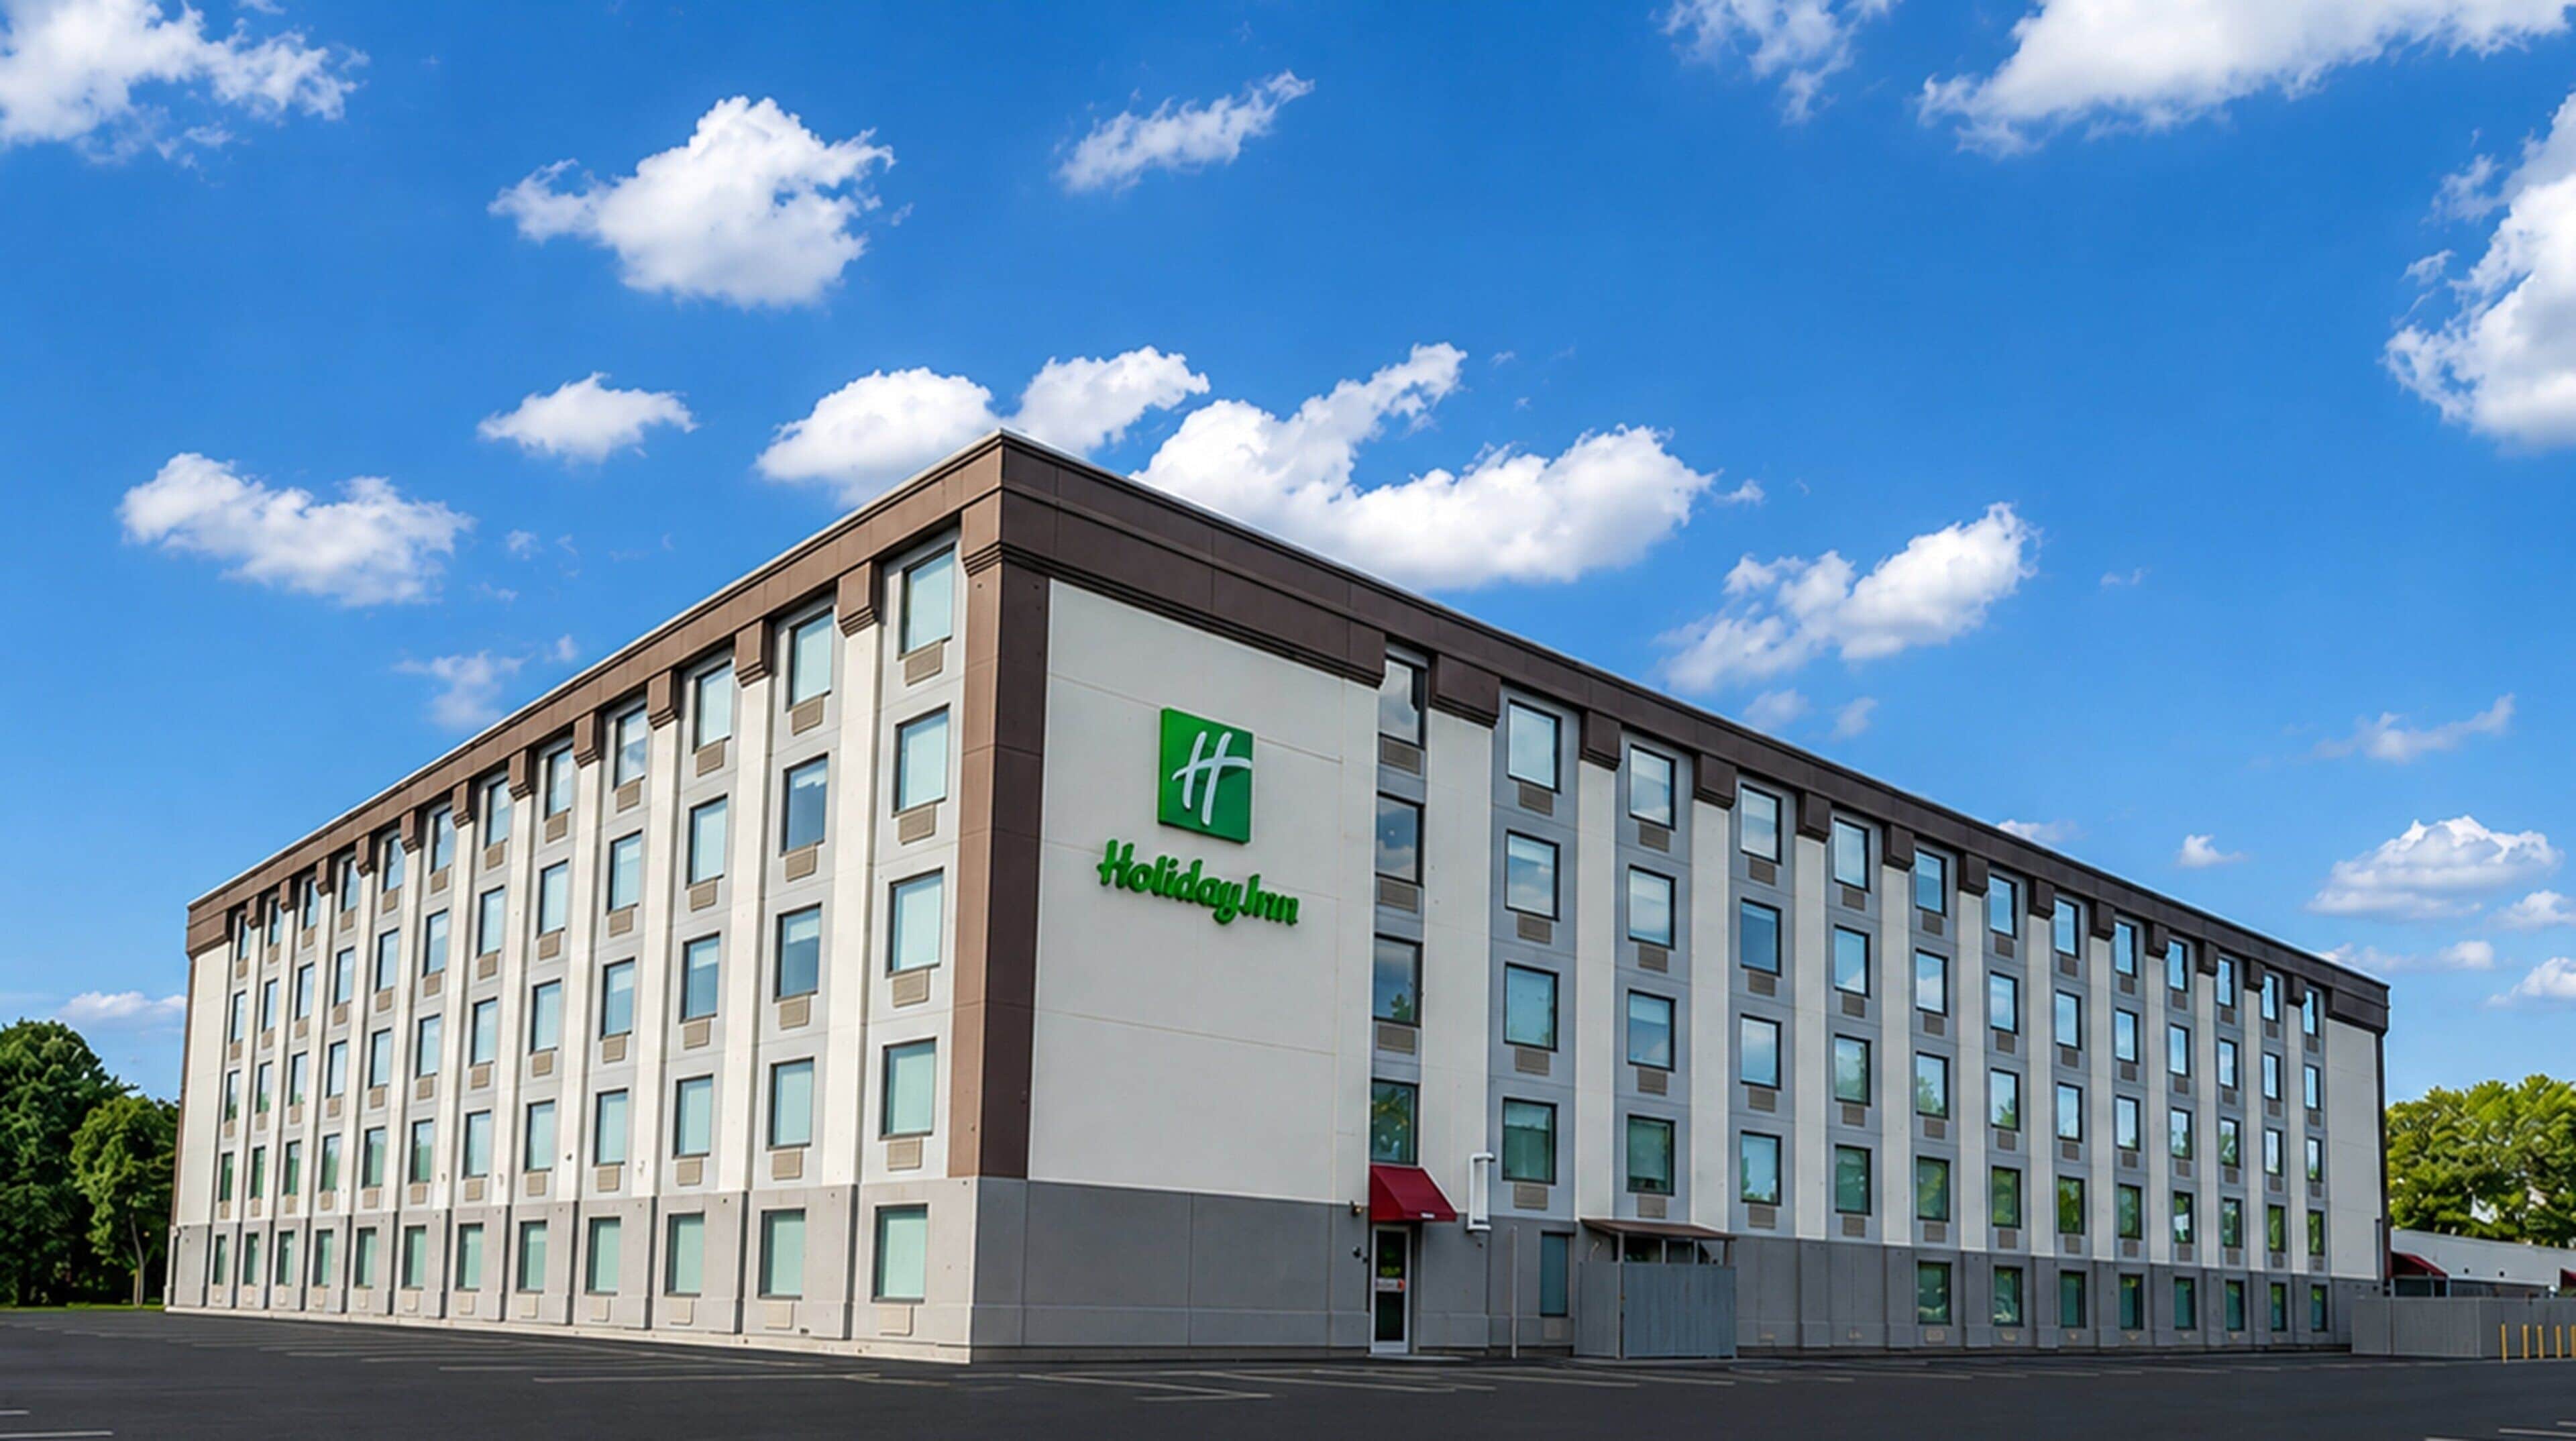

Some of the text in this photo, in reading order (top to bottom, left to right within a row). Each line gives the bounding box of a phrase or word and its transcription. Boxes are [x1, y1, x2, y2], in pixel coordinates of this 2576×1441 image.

[1172, 731, 1252, 826] H
[1096, 839, 1299, 926] Holiday Inn
